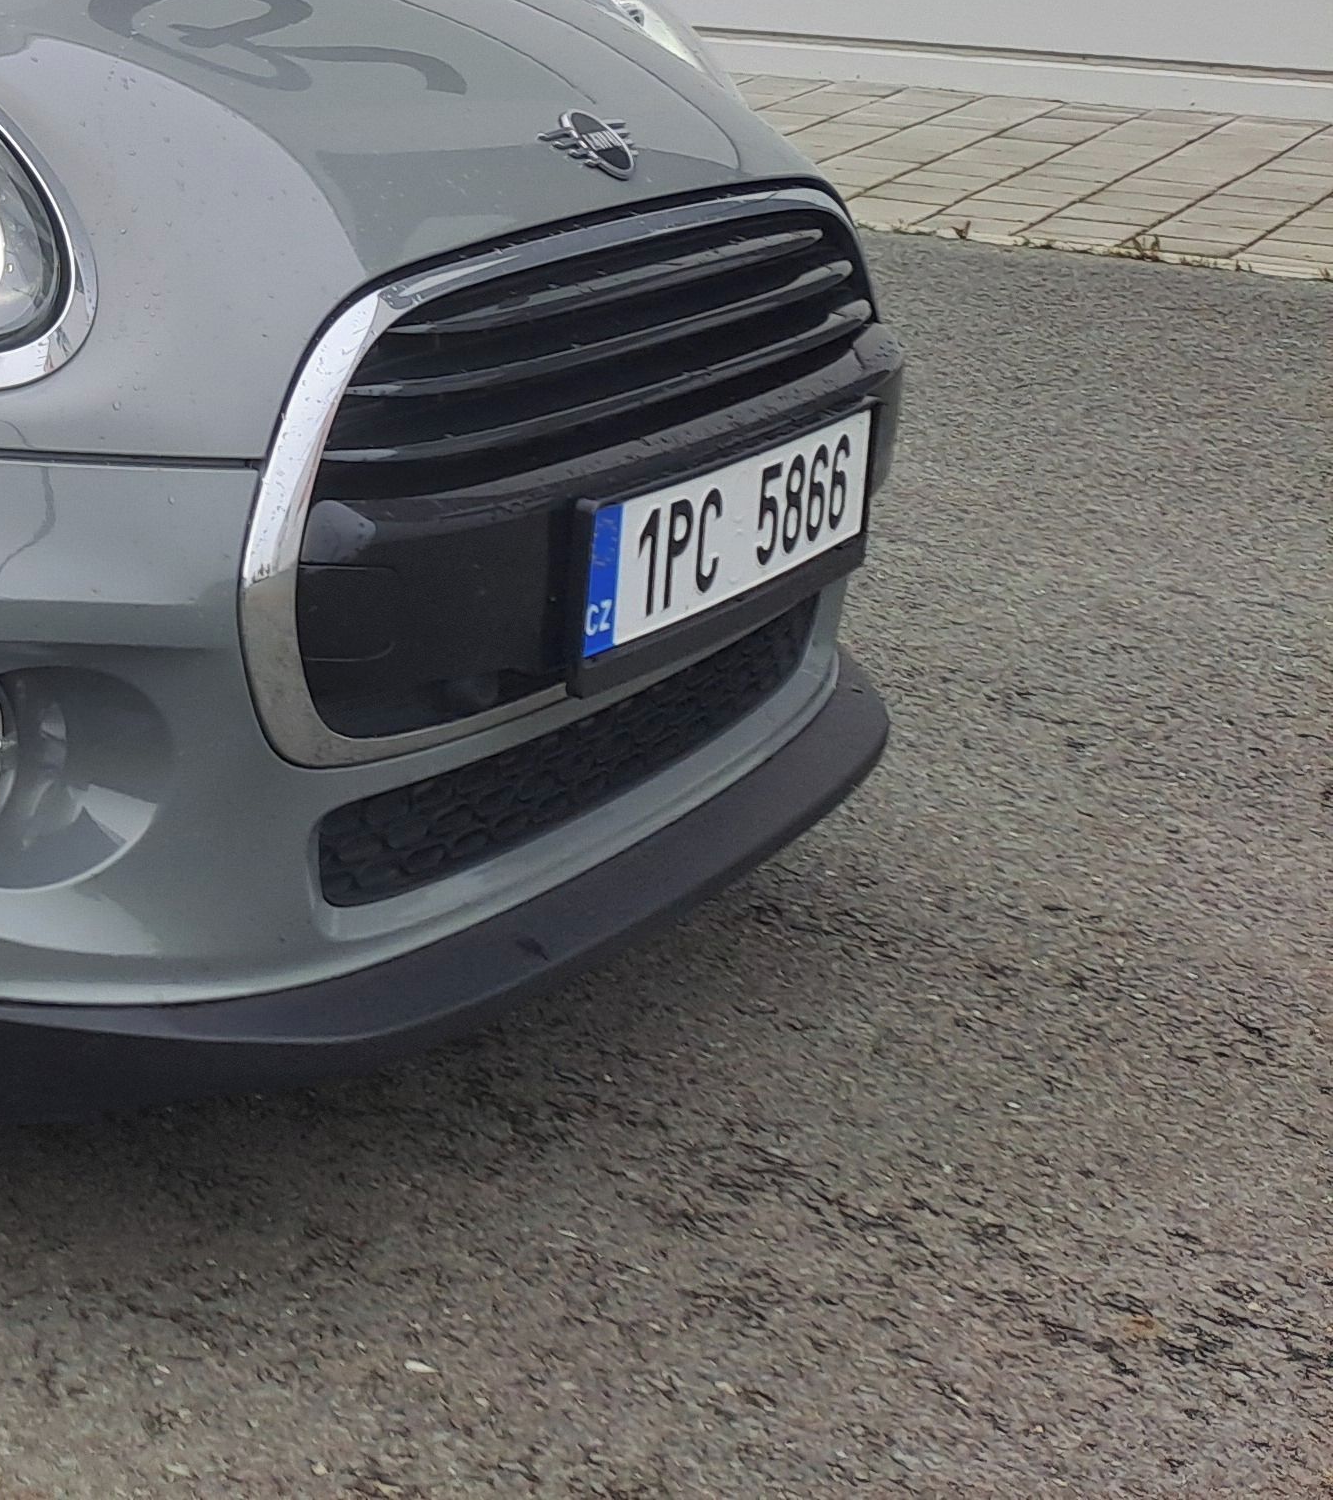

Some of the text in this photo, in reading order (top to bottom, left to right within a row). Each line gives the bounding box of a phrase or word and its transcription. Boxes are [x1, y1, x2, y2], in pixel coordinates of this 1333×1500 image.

[638, 434, 851, 618] 1PC 5866
[584, 601, 611, 636] CZ
